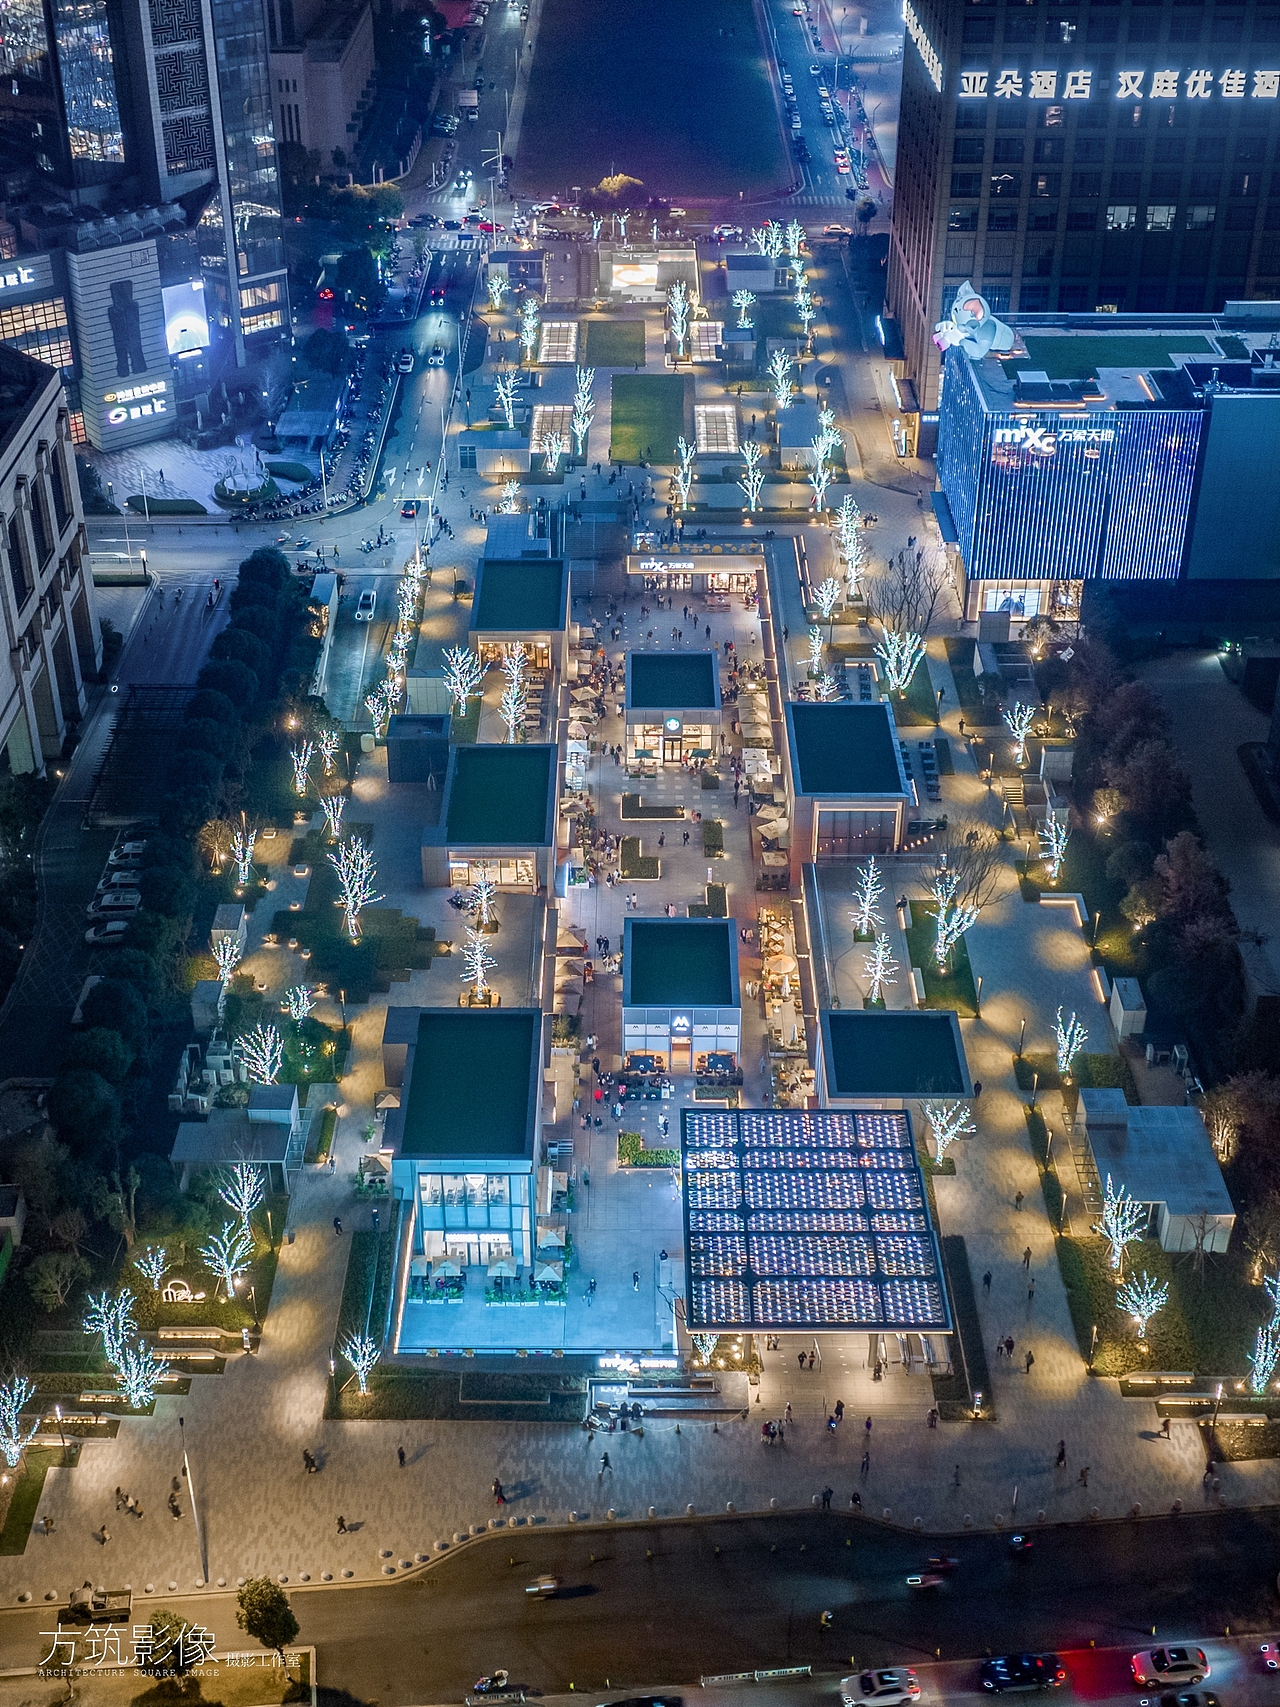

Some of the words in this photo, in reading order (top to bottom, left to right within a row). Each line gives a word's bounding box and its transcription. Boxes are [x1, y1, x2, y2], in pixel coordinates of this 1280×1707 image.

[959, 70, 1091, 98] 亚朵酒店
[1059, 429, 1114, 441] 万象天地
